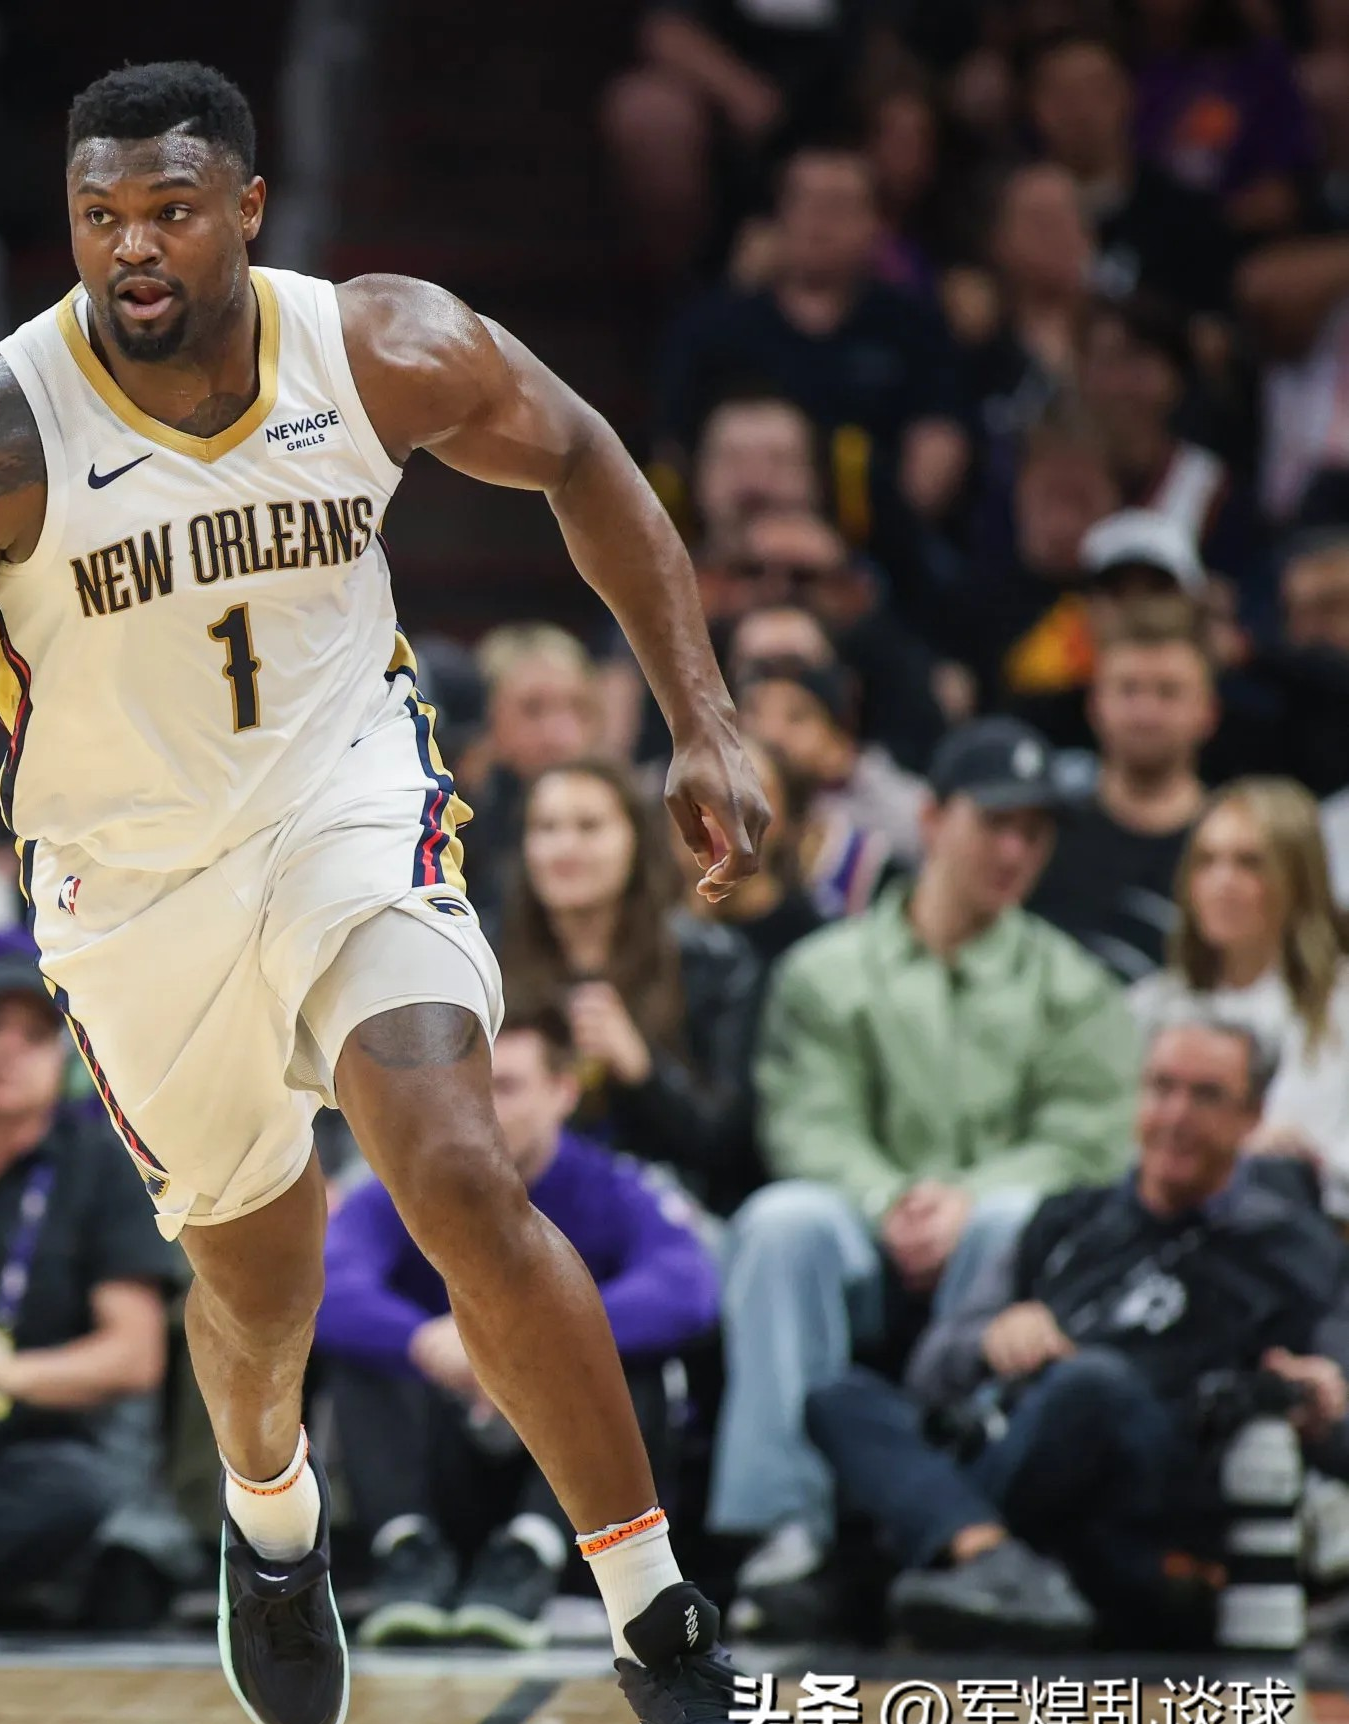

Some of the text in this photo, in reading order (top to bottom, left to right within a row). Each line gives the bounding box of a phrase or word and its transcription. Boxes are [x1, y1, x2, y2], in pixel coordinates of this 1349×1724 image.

[265, 409, 340, 443] NEWAGE
[286, 433, 326, 452] GRILLS
[69, 495, 373, 619] NEW ORLEANS
[206, 601, 262, 734] 1
